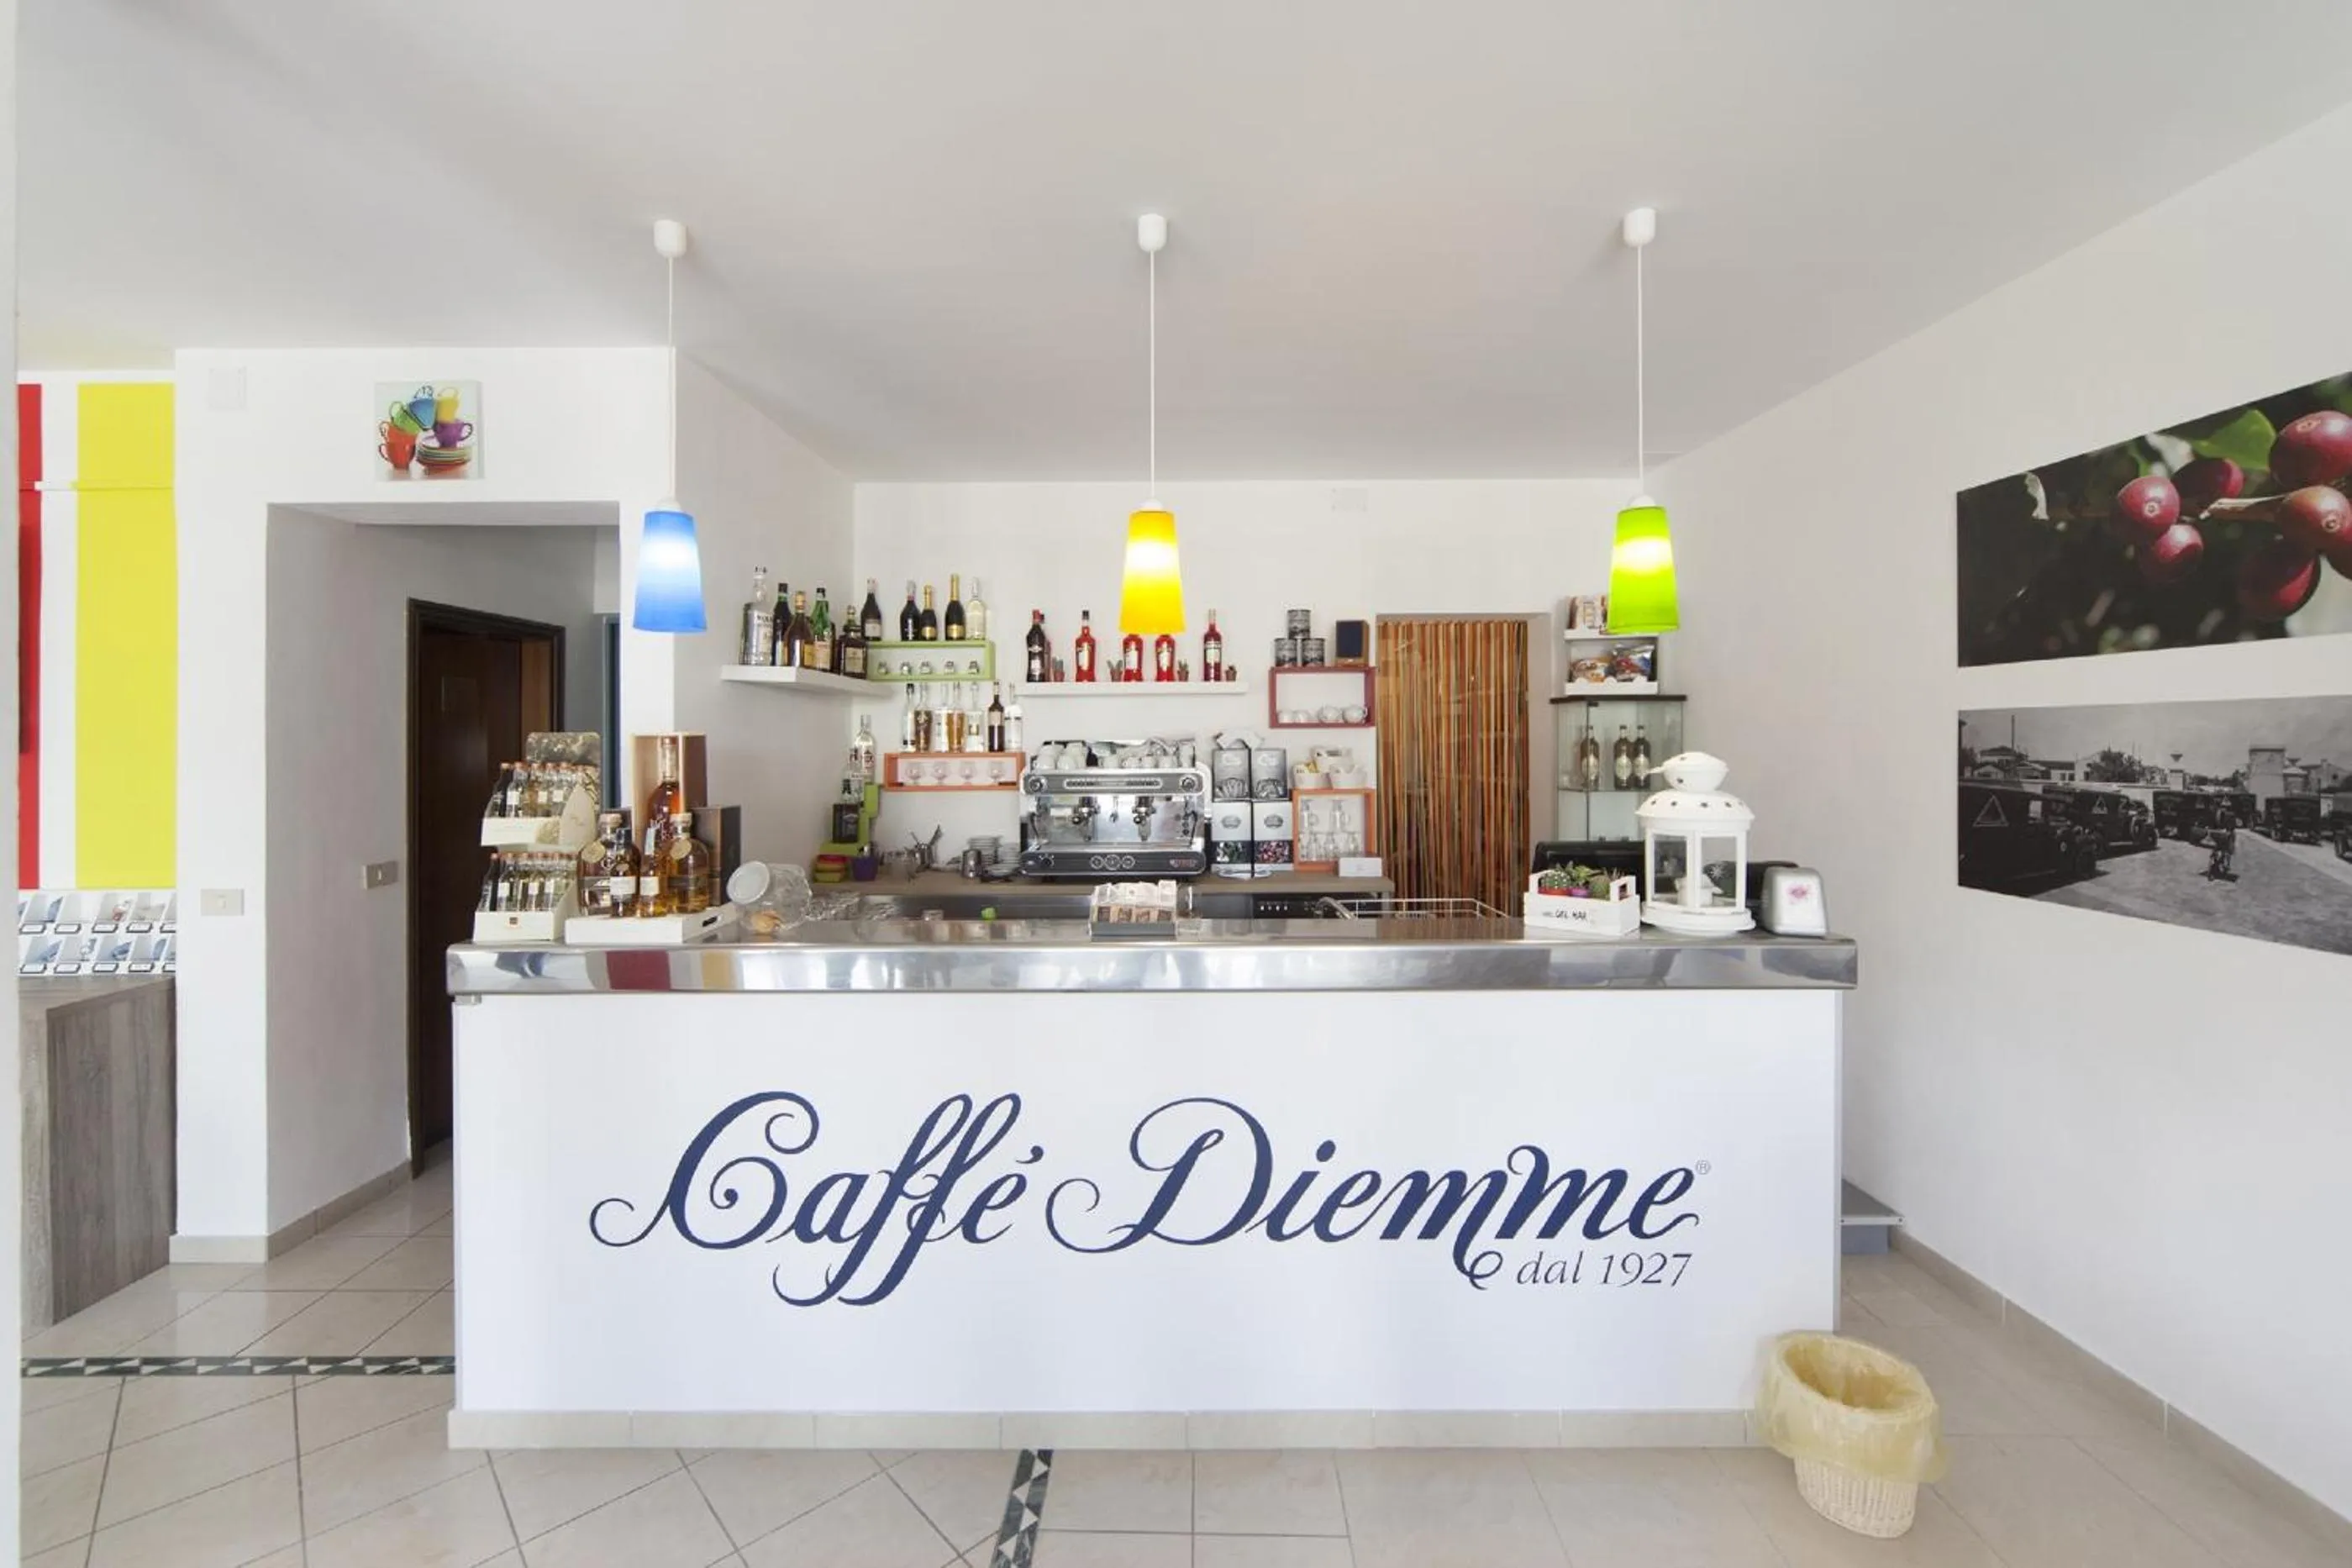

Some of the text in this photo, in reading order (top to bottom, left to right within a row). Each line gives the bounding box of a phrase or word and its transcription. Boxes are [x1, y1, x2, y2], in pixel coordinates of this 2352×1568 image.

[1045, 1097, 1700, 1291] Diemme
[1516, 1250, 1692, 1287] dal 1927
